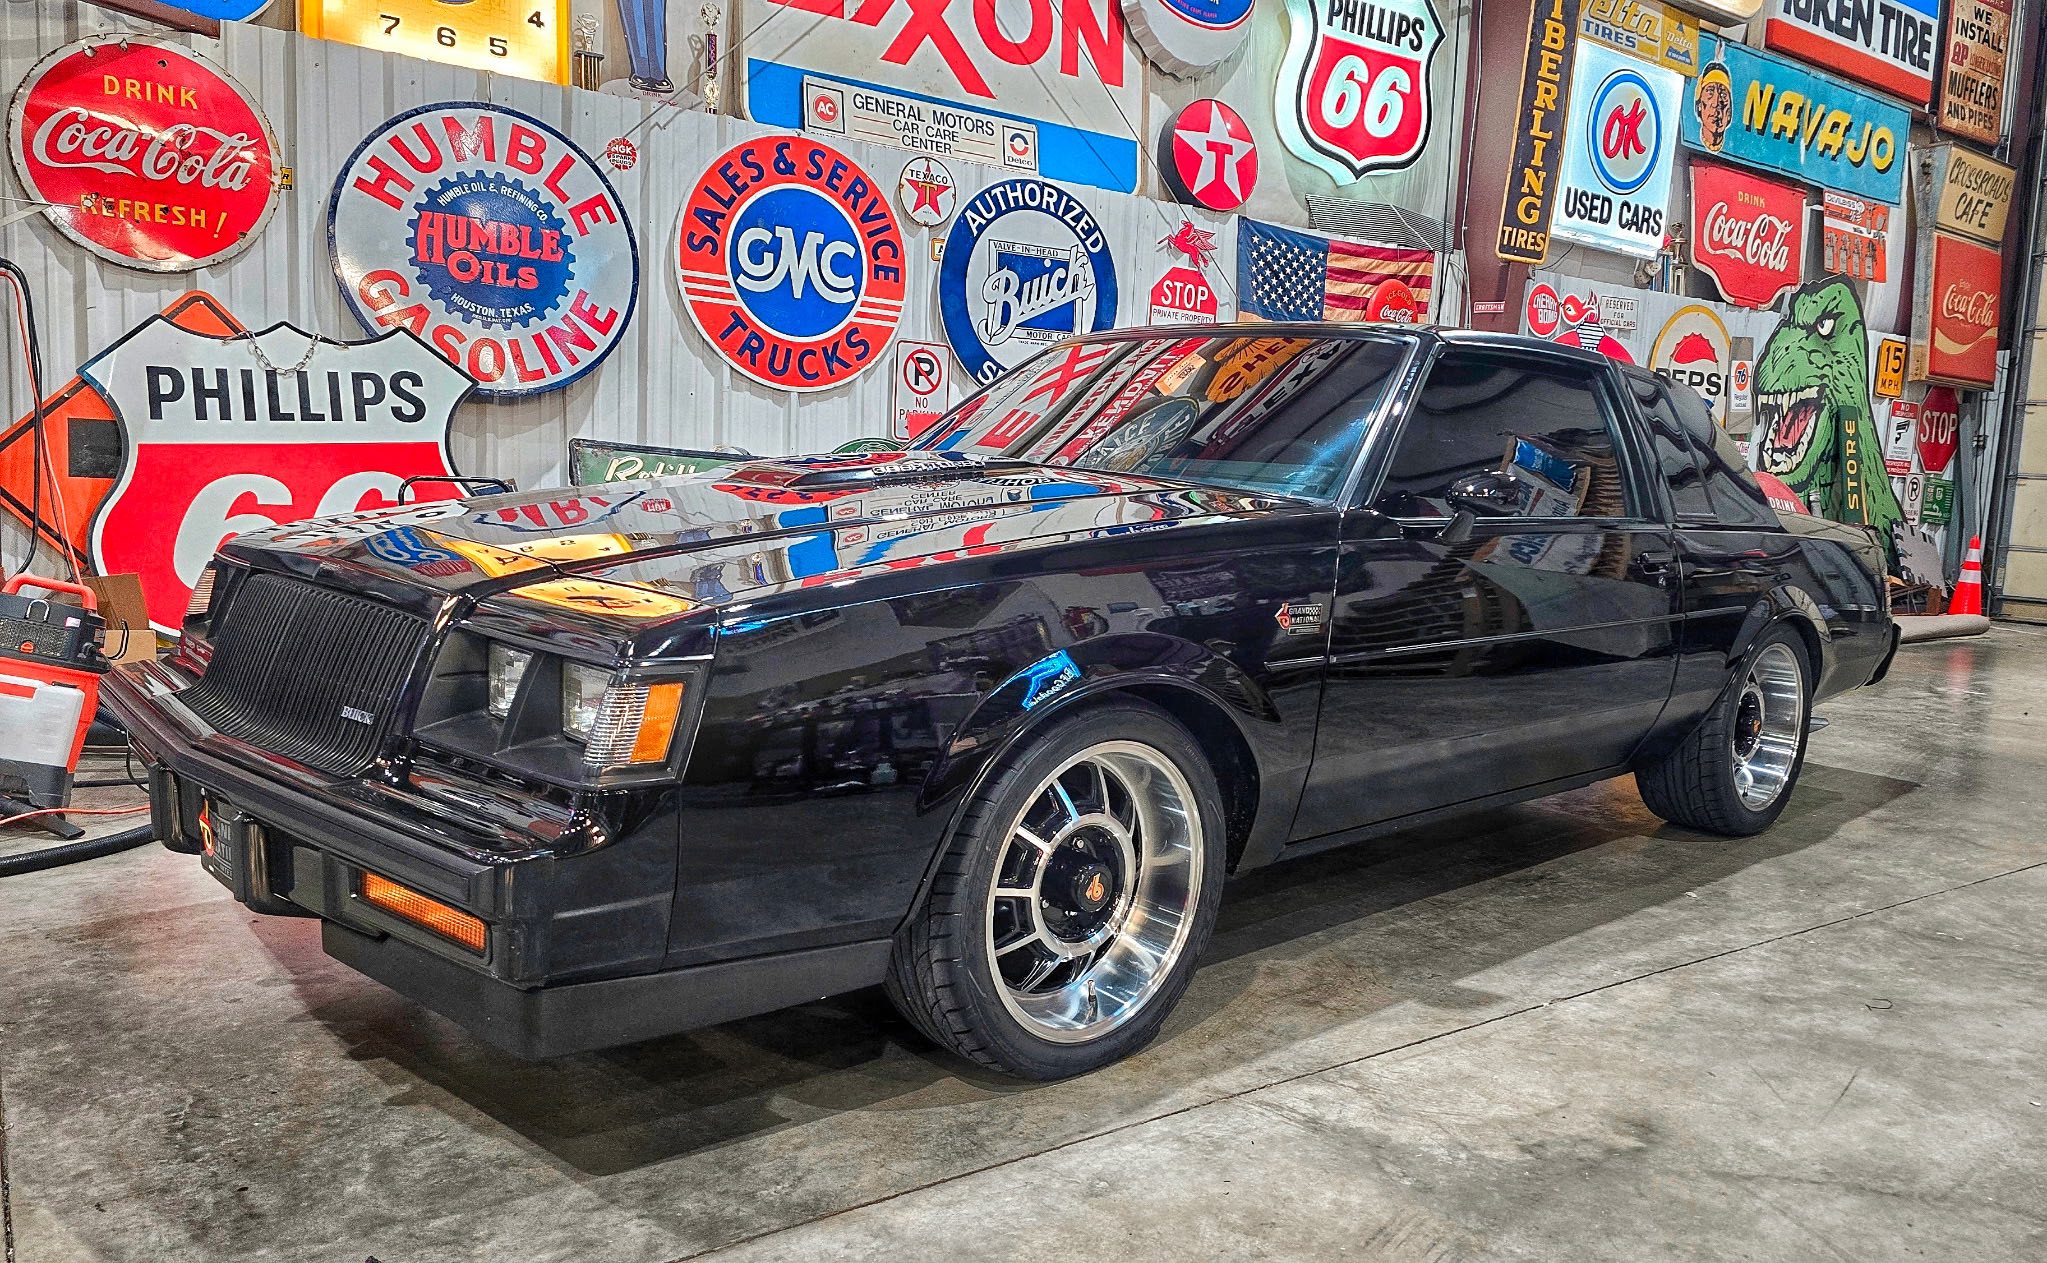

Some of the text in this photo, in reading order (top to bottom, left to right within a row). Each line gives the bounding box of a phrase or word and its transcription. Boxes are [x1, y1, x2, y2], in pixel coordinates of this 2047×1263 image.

[380, 15, 400, 35] 7
[527, 11, 545, 29] 4
[1974, 6, 1993, 26] WE
[437, 27, 457, 48] 6
[490, 37, 508, 57] 5
[1583, 19, 1637, 49] TIRES
[1880, 2, 1933, 72] TIRE
[1955, 17, 2003, 53] INSTALL
[104, 74, 198, 110] DRINK
[1322, 55, 1411, 138] 66
[1947, 70, 1998, 111] MUFFLERS
[817, 93, 995, 136] AC GENERAL MOTORS
[1602, 98, 1647, 160] OK
[1743, 80, 1896, 172] NAVAJO
[1947, 101, 1994, 131] AND PIPES
[893, 120, 960, 142] CAR CARE
[32, 107, 259, 191] Coca-Cola
[612, 145, 632, 155] NGK
[902, 135, 1033, 167] CENTER Delco
[353, 115, 618, 237] HUMBLE
[909, 168, 948, 185] TEXACO
[1949, 156, 2013, 203] CROSSROADS
[437, 183, 470, 207] HUMBLE
[471, 181, 487, 193] OIL
[500, 185, 538, 212] REFINING
[1738, 190, 1766, 209] DRINK
[1955, 192, 1994, 229] CAFE
[687, 142, 900, 283] SALES & SERVICE
[964, 182, 1104, 253] AUTHORIZED
[1564, 186, 1662, 238] USED CARS
[417, 210, 565, 262] HUMBLE
[1503, 227, 1546, 252] TIRES
[1704, 202, 1793, 272] Coca-Cola
[447, 250, 540, 290] OILS
[736, 226, 857, 304] GMC
[977, 244, 1095, 347] Buick
[1161, 280, 1209, 311] STOP
[1475, 303, 1505, 312] CRAFTSMAN
[1533, 293, 1557, 309] CHERRY
[1605, 298, 1634, 310] RESERVED
[1942, 283, 1998, 328] Coca-Cola
[359, 269, 618, 383] GASOLINE
[1153, 309, 1213, 324] PRIVATE PROPERTY
[1380, 305, 1414, 322] Coca-Cola
[1537, 308, 1558, 324] BOMB
[1601, 318, 1636, 328] OFFICIAL CARS
[1613, 311, 1624, 319] FOR
[719, 310, 871, 381] TRUCKS
[1026, 331, 1053, 341] MOTOR
[1884, 345, 1903, 374] 15
[1737, 368, 1746, 383] 76
[146, 366, 427, 423] PHILLIPS
[915, 397, 928, 408] NO
[1901, 403, 1910, 411] NO
[1920, 409, 1958, 445] STOP
[1845, 419, 1860, 510] STORE
[1768, 497, 1797, 512] DRINK
[1288, 606, 1309, 615] GRAND
[1290, 615, 1321, 624] NATIONAL
[341, 705, 375, 726] BUICK
